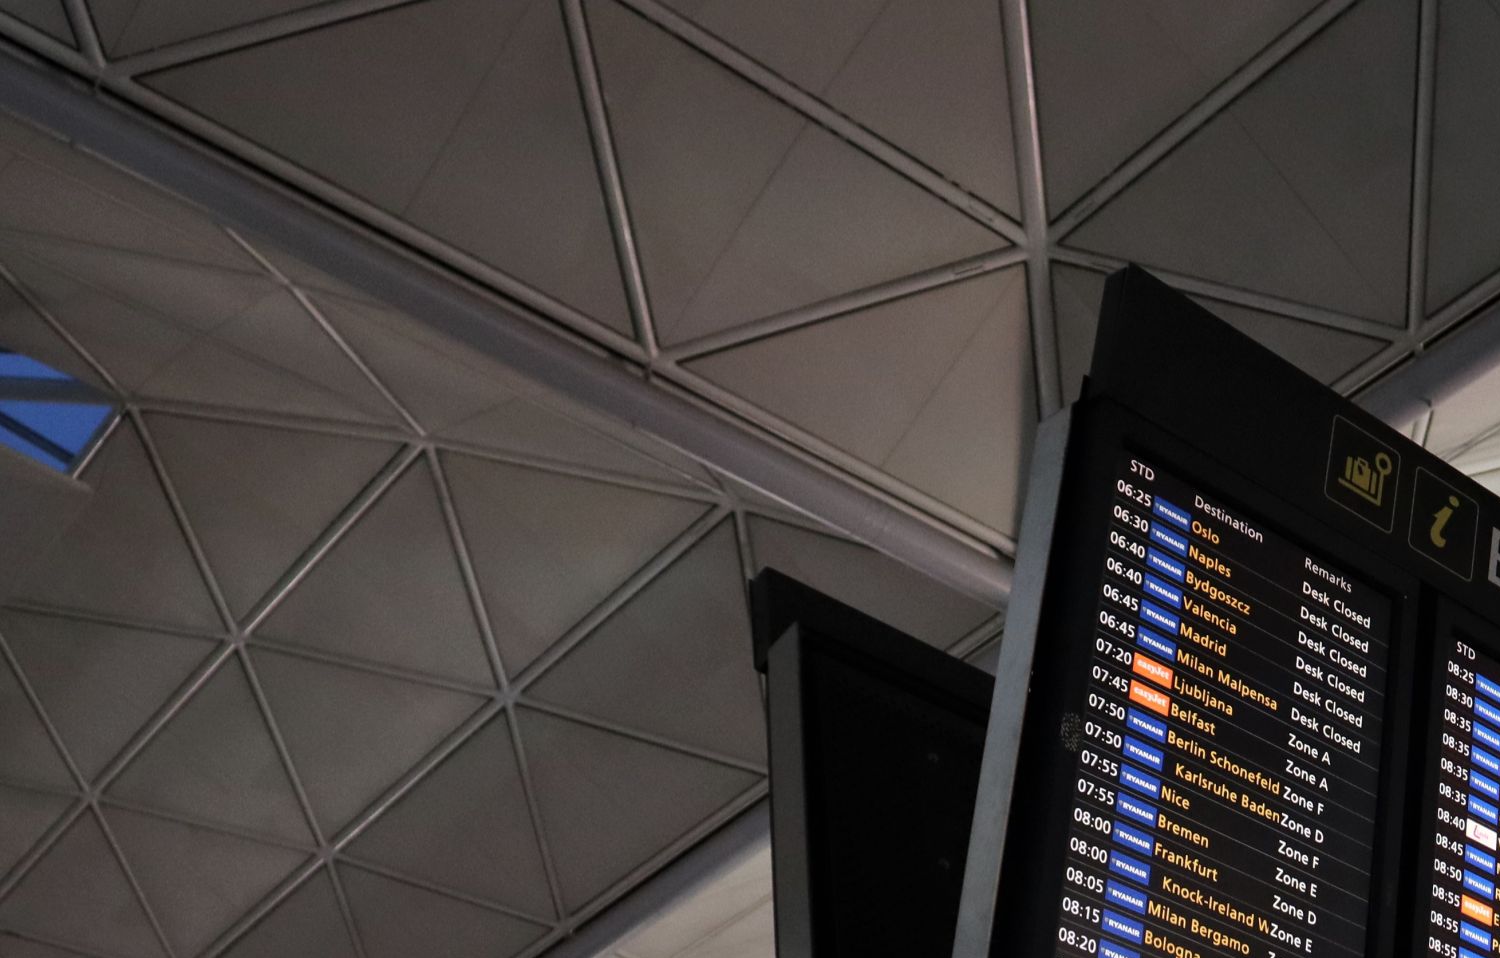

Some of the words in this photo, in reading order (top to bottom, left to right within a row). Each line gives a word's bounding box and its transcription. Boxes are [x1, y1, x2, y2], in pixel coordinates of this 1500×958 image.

[1113, 504, 1148, 532] 06:30
[1188, 544, 1231, 577] Naples
[1300, 605, 1327, 631] Desk
[1331, 623, 1368, 653] Closed
[1116, 479, 1151, 506] 06:25
[1191, 520, 1219, 544] Oslo
[1302, 580, 1329, 606] Desk
[1333, 599, 1370, 628] Closed
[1130, 459, 1154, 480] STD
[1194, 494, 1263, 543] Destination
[1304, 556, 1351, 592] Remarks
[1102, 583, 1138, 611] 06:45
[1179, 622, 1226, 656] Madrid
[1293, 681, 1321, 706] Desk
[1324, 698, 1362, 728] Closed
[1109, 530, 1145, 558] 06:40
[1185, 570, 1250, 615] Bydgoszcz
[1297, 630, 1325, 656] Desk
[1329, 648, 1366, 678] Closed
[1456, 640, 1475, 660] STD
[1095, 637, 1132, 665] 07:20
[1173, 675, 1232, 715] Ljubljana
[1287, 732, 1318, 758] Zone
[1321, 751, 1330, 765] A
[1445, 684, 1473, 708] 08:30
[1447, 660, 1474, 684] 08:25
[1088, 693, 1125, 720] 07:50
[1167, 729, 1205, 759] Berlin
[1209, 750, 1280, 794] Schonefeld
[1282, 785, 1313, 811] Zone
[1316, 802, 1324, 815] F
[1077, 778, 1114, 805] 07:55
[1157, 813, 1208, 848] Bremen
[1274, 866, 1306, 892] Zone
[1309, 882, 1317, 897] E
[1437, 807, 1465, 830] 08:40
[1062, 896, 1100, 923] 08:15
[1066, 866, 1103, 893] 08:05
[1147, 899, 1186, 928] Milan
[1190, 918, 1249, 954] Bergamo
